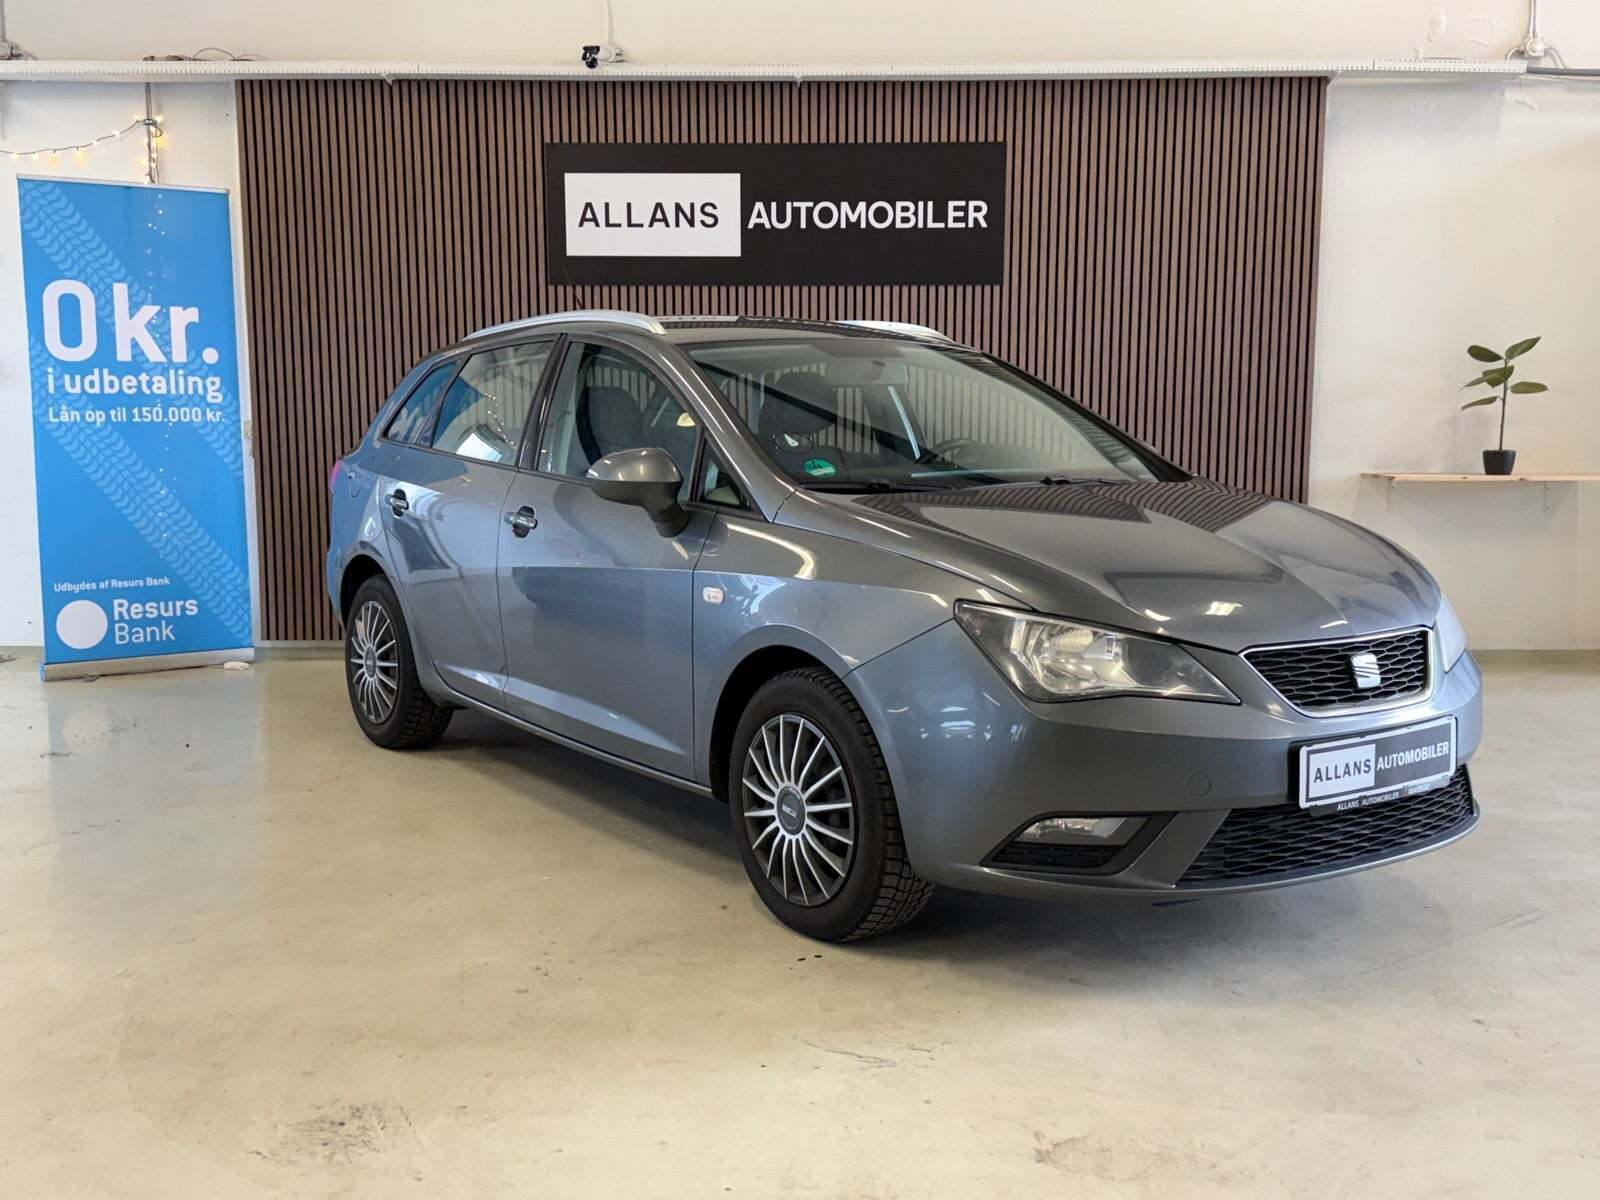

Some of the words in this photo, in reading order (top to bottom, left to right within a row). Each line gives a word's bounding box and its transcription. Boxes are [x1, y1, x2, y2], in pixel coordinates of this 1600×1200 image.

[577, 201, 720, 229] ALLANS
[747, 200, 988, 229] AUTOMOBILER
[42, 279, 98, 362] 0
[113, 282, 219, 364] kr.
[47, 367, 54, 394] i
[64, 368, 223, 403] udbetaling
[50, 404, 80, 422] Lån
[85, 409, 106, 426] op
[110, 406, 127, 422] til
[132, 406, 201, 423] 150.000
[207, 407, 225, 422] kr.
[54, 581, 97, 593] Udbydes
[99, 579, 110, 590] af
[111, 579, 144, 589] Resurs
[146, 576, 170, 586] Bank
[113, 598, 198, 620] Resurs
[114, 620, 176, 644] Bank
[1313, 758, 1372, 783] ALLANS
[1376, 741, 1450, 771] AUTOMOBILER
[1336, 800, 1360, 811] ALLANS
[1361, 791, 1399, 807] AUTOMOBILER
